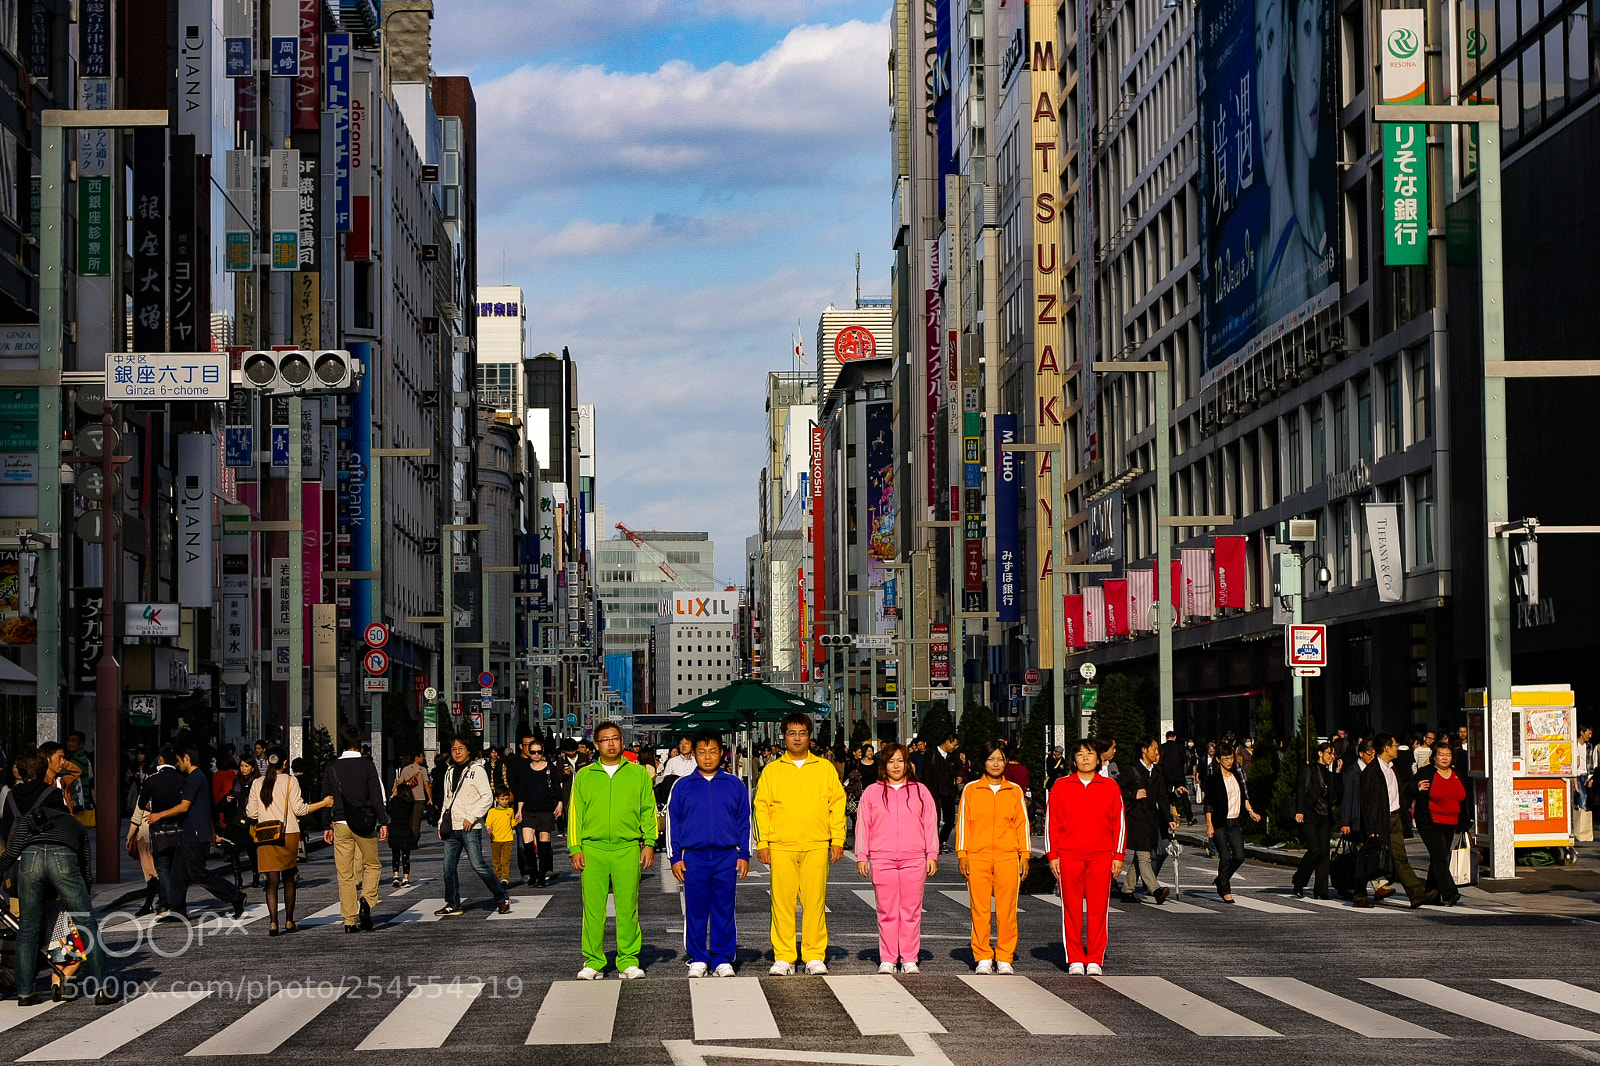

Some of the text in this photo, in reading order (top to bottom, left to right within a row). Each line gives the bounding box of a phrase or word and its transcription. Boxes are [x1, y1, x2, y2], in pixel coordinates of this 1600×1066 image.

[182, 26, 204, 112] DIANA
[352, 100, 365, 168] docomo
[1393, 126, 1418, 246] りそな銀行
[88, 179, 102, 271] 西銀座診療所
[174, 262, 193, 341] ヨシノヤ
[114, 355, 147, 364] 中央区
[115, 365, 219, 384] 銀座六丁目
[126, 385, 209, 395] Ginza 6-chome
[814, 432, 822, 497] MITSUKOSHI
[1003, 430, 1014, 482] MZUHO
[349, 452, 366, 527] citibank
[182, 476, 204, 563] DIANA
[540, 497, 552, 568] 教文館
[1377, 518, 1388, 562] TIFFANY
[1002, 550, 1014, 606] みずほ銀行
[1381, 564, 1390, 572] &
[369, 630, 383, 640] 50
[676, 597, 729, 617] LIXIL
[229, 623, 241, 653] 菊水
